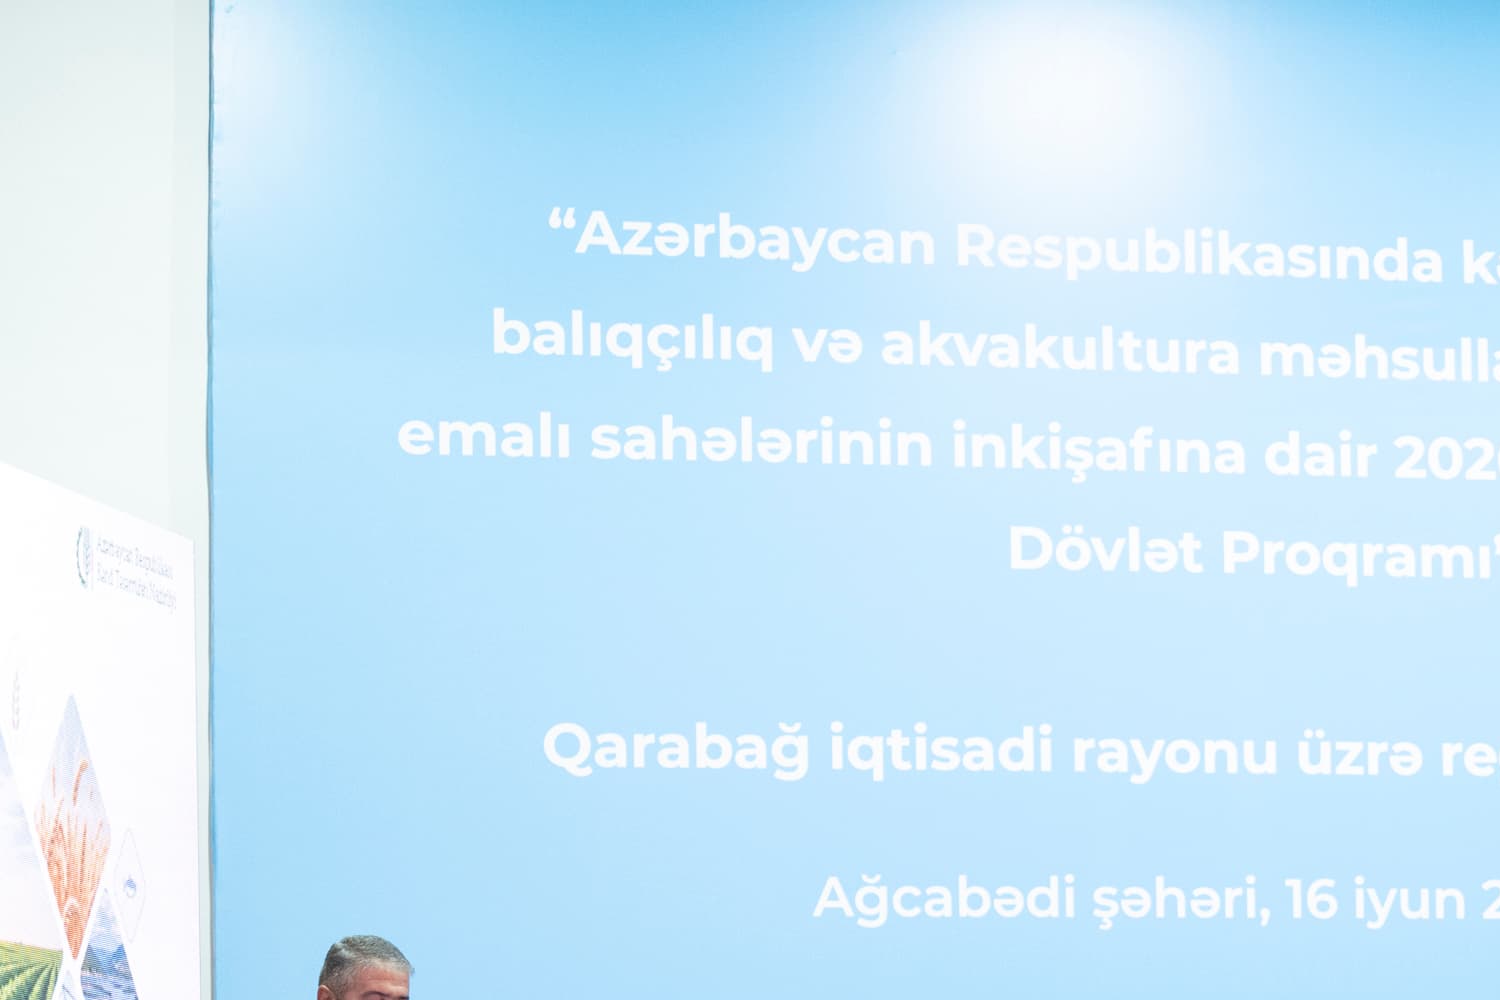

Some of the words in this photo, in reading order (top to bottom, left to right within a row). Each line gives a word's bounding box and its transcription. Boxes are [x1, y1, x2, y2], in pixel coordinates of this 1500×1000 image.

[548, 206, 935, 272] “Azərbaycan
[957, 223, 1443, 282] Respublikasında
[493, 307, 773, 373] balıqçılıq
[791, 327, 863, 364] və
[881, 319, 1240, 375] akvakultura
[397, 411, 570, 458] emalı
[591, 414, 932, 467] sahələrinin
[952, 418, 1246, 484] inkişafına
[1264, 429, 1378, 478] dair
[1010, 524, 1204, 574] Dövlət
[543, 720, 809, 781] Qarabağ
[830, 720, 1053, 782] iqtisadi
[1073, 737, 1277, 785] rayonu
[1298, 728, 1423, 777] üzrə
[812, 873, 1075, 929] Ağcabədi
[1093, 874, 1271, 931] şəhəri,
[1284, 878, 1338, 920] 16
[1354, 875, 1465, 930] iyun
